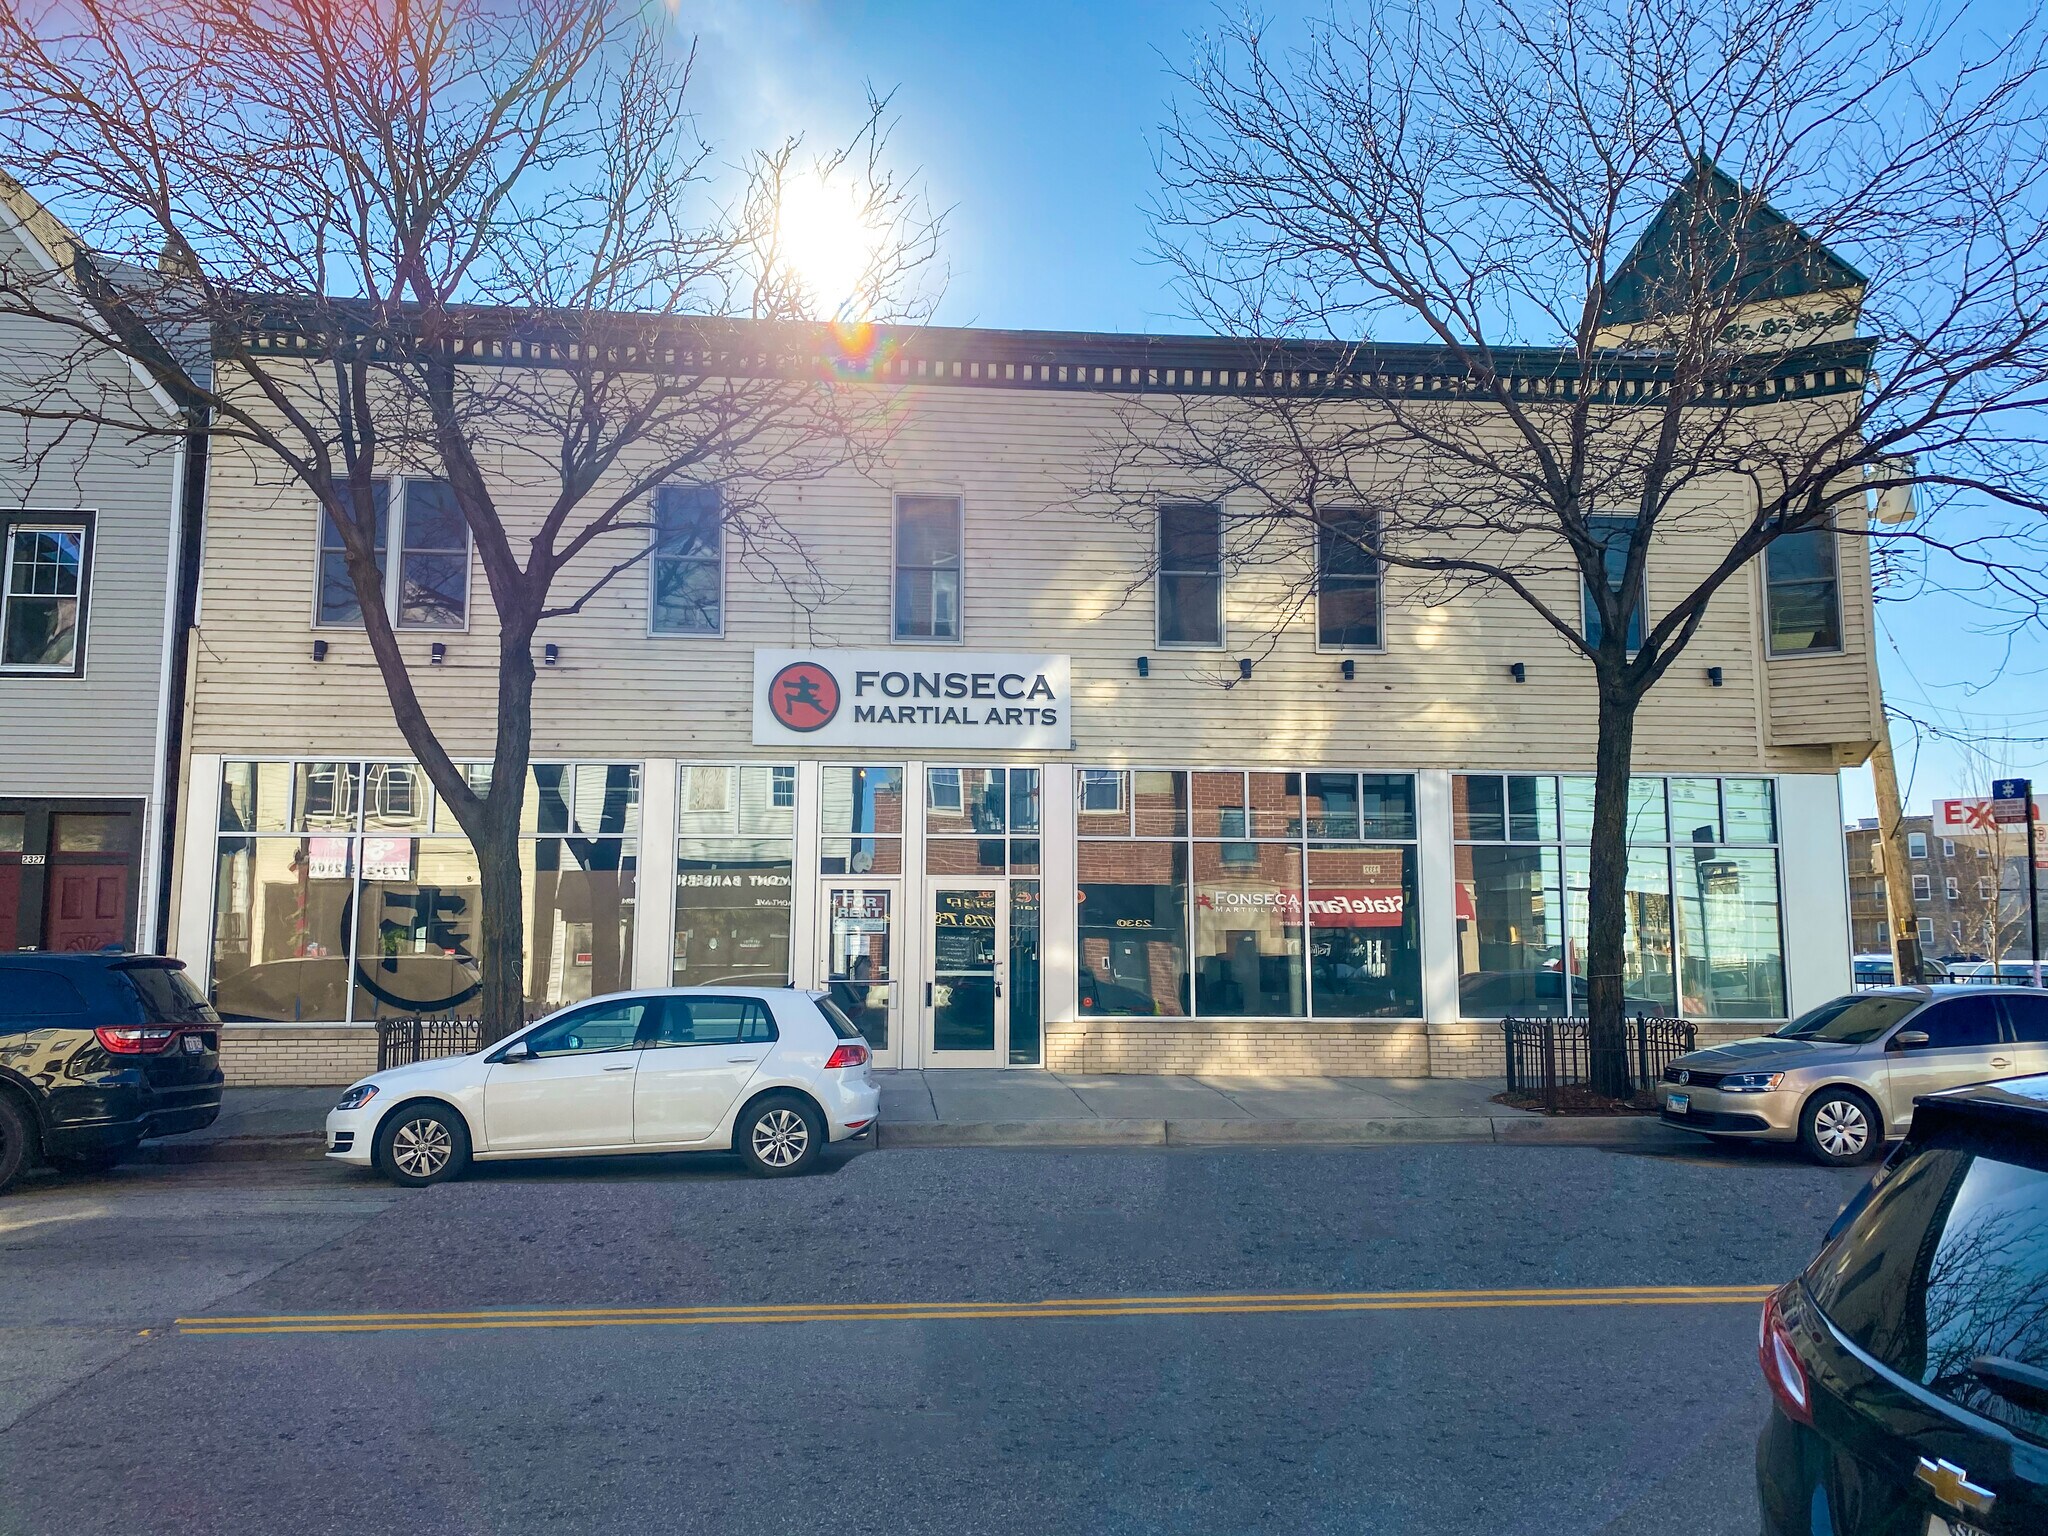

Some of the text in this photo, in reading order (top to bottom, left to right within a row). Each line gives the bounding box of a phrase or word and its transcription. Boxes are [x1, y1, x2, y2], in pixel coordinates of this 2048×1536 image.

[855, 671, 1056, 700] FONSECA
[854, 705, 1057, 726] MARTIAL ARTS
[22, 855, 44, 863] 2327
[842, 896, 877, 907] FOR
[1215, 891, 1300, 905] FONSECA
[837, 907, 883, 918] RENT
